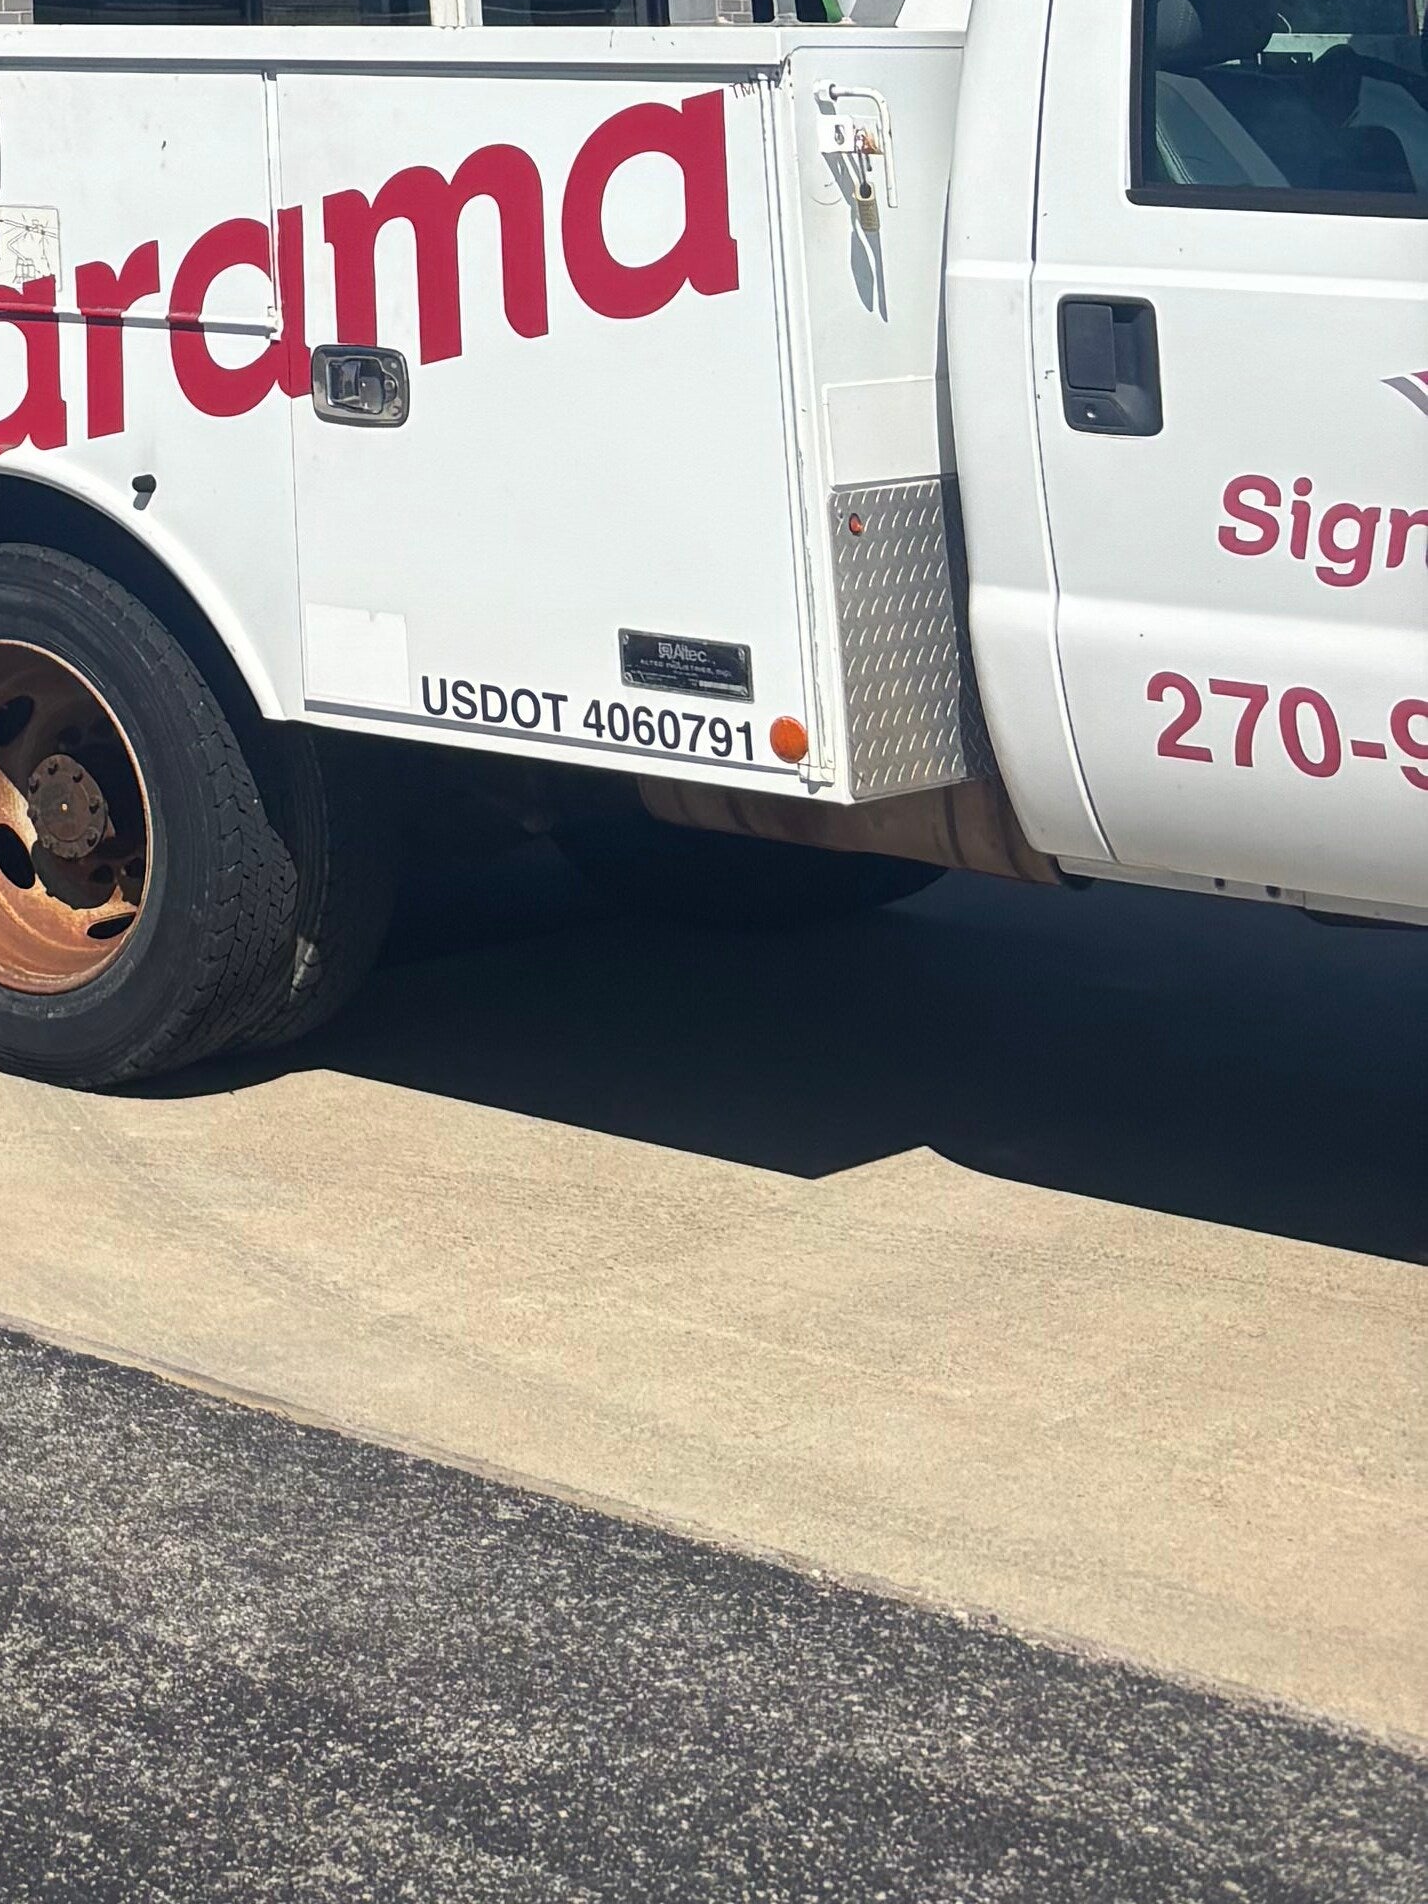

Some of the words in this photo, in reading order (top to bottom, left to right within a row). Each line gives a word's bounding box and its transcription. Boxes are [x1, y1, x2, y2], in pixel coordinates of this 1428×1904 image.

[672, 644, 708, 663] Altec
[421, 675, 568, 733] USDOT
[582, 699, 755, 761] 4060791
